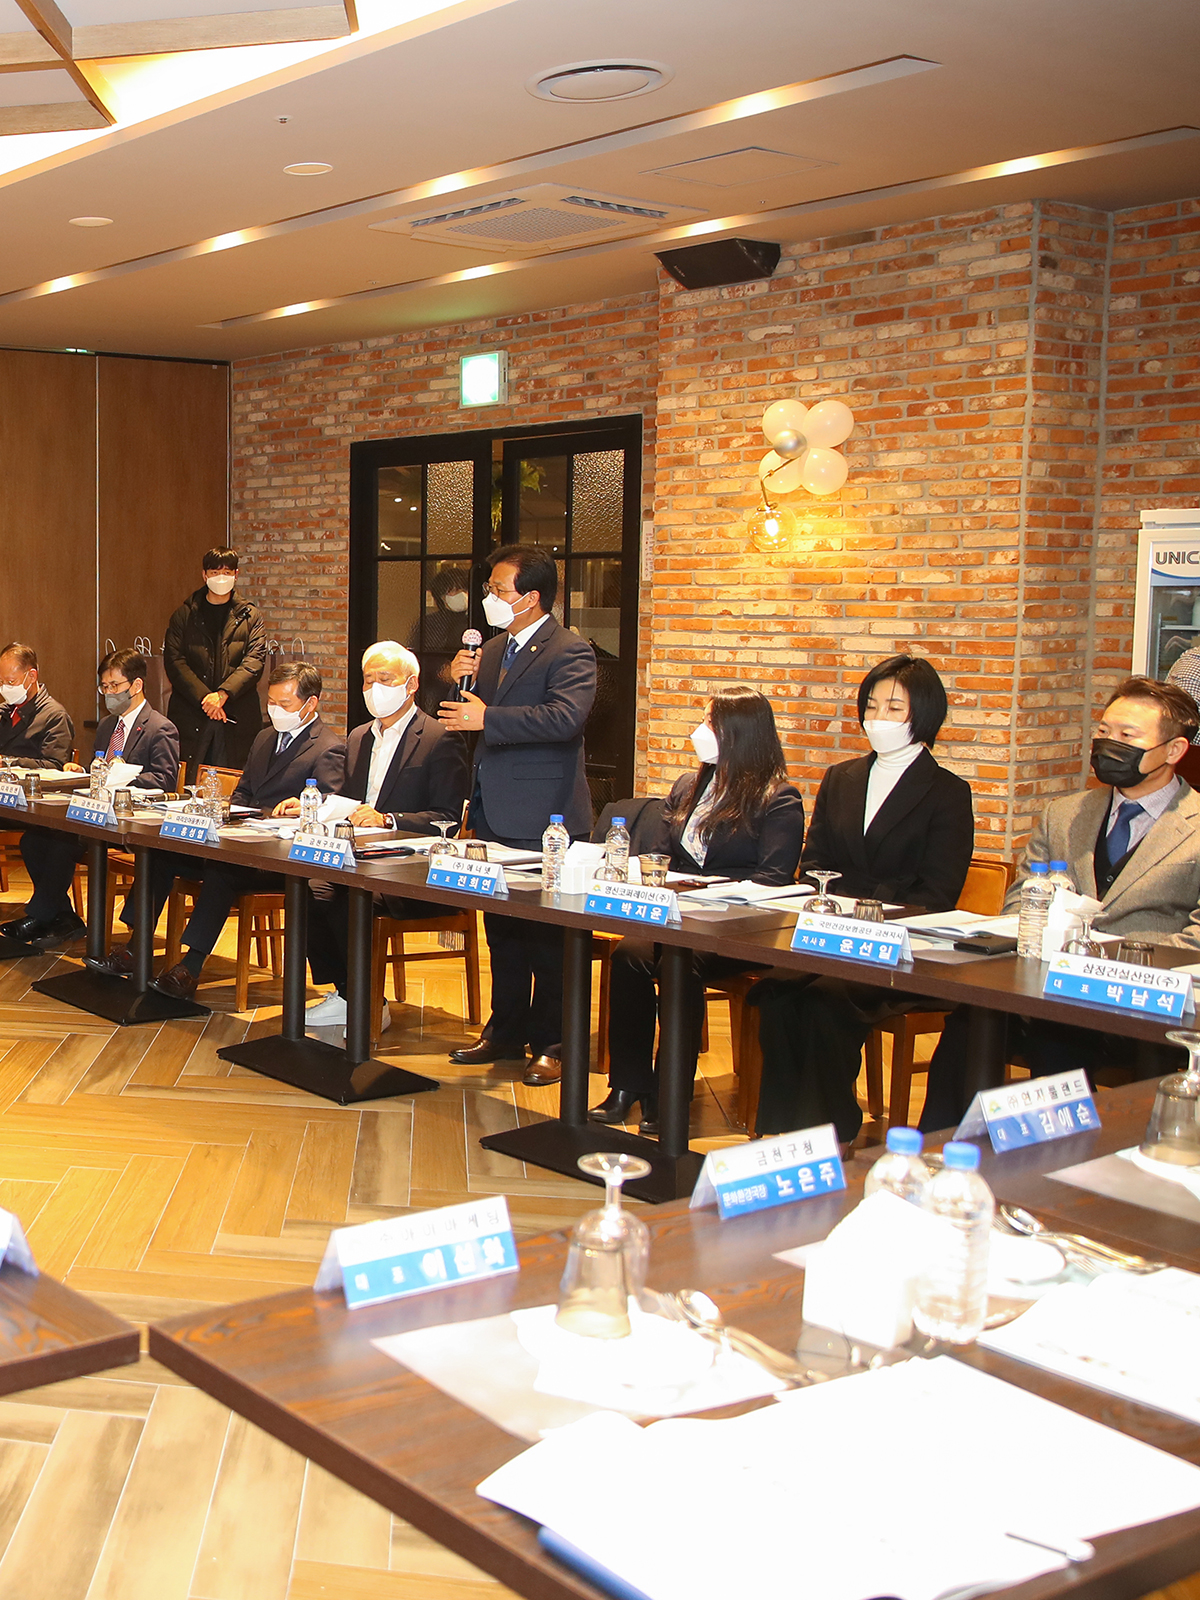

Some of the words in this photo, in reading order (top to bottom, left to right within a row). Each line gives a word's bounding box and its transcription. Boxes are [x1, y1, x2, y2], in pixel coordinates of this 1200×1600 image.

[1155, 550, 1200, 565] UNIC
[457, 874, 492, 892] 전희연
[621, 901, 663, 921] 박지윤
[801, 935, 826, 947] 지사장
[839, 938, 893, 960] 윤선일
[1083, 962, 1181, 988] 삼정건설산업(주)
[1107, 984, 1176, 1012] 박남석
[1038, 1102, 1093, 1135] 김애순
[755, 1139, 814, 1167] 금천구청
[775, 1161, 837, 1197] 노은주
